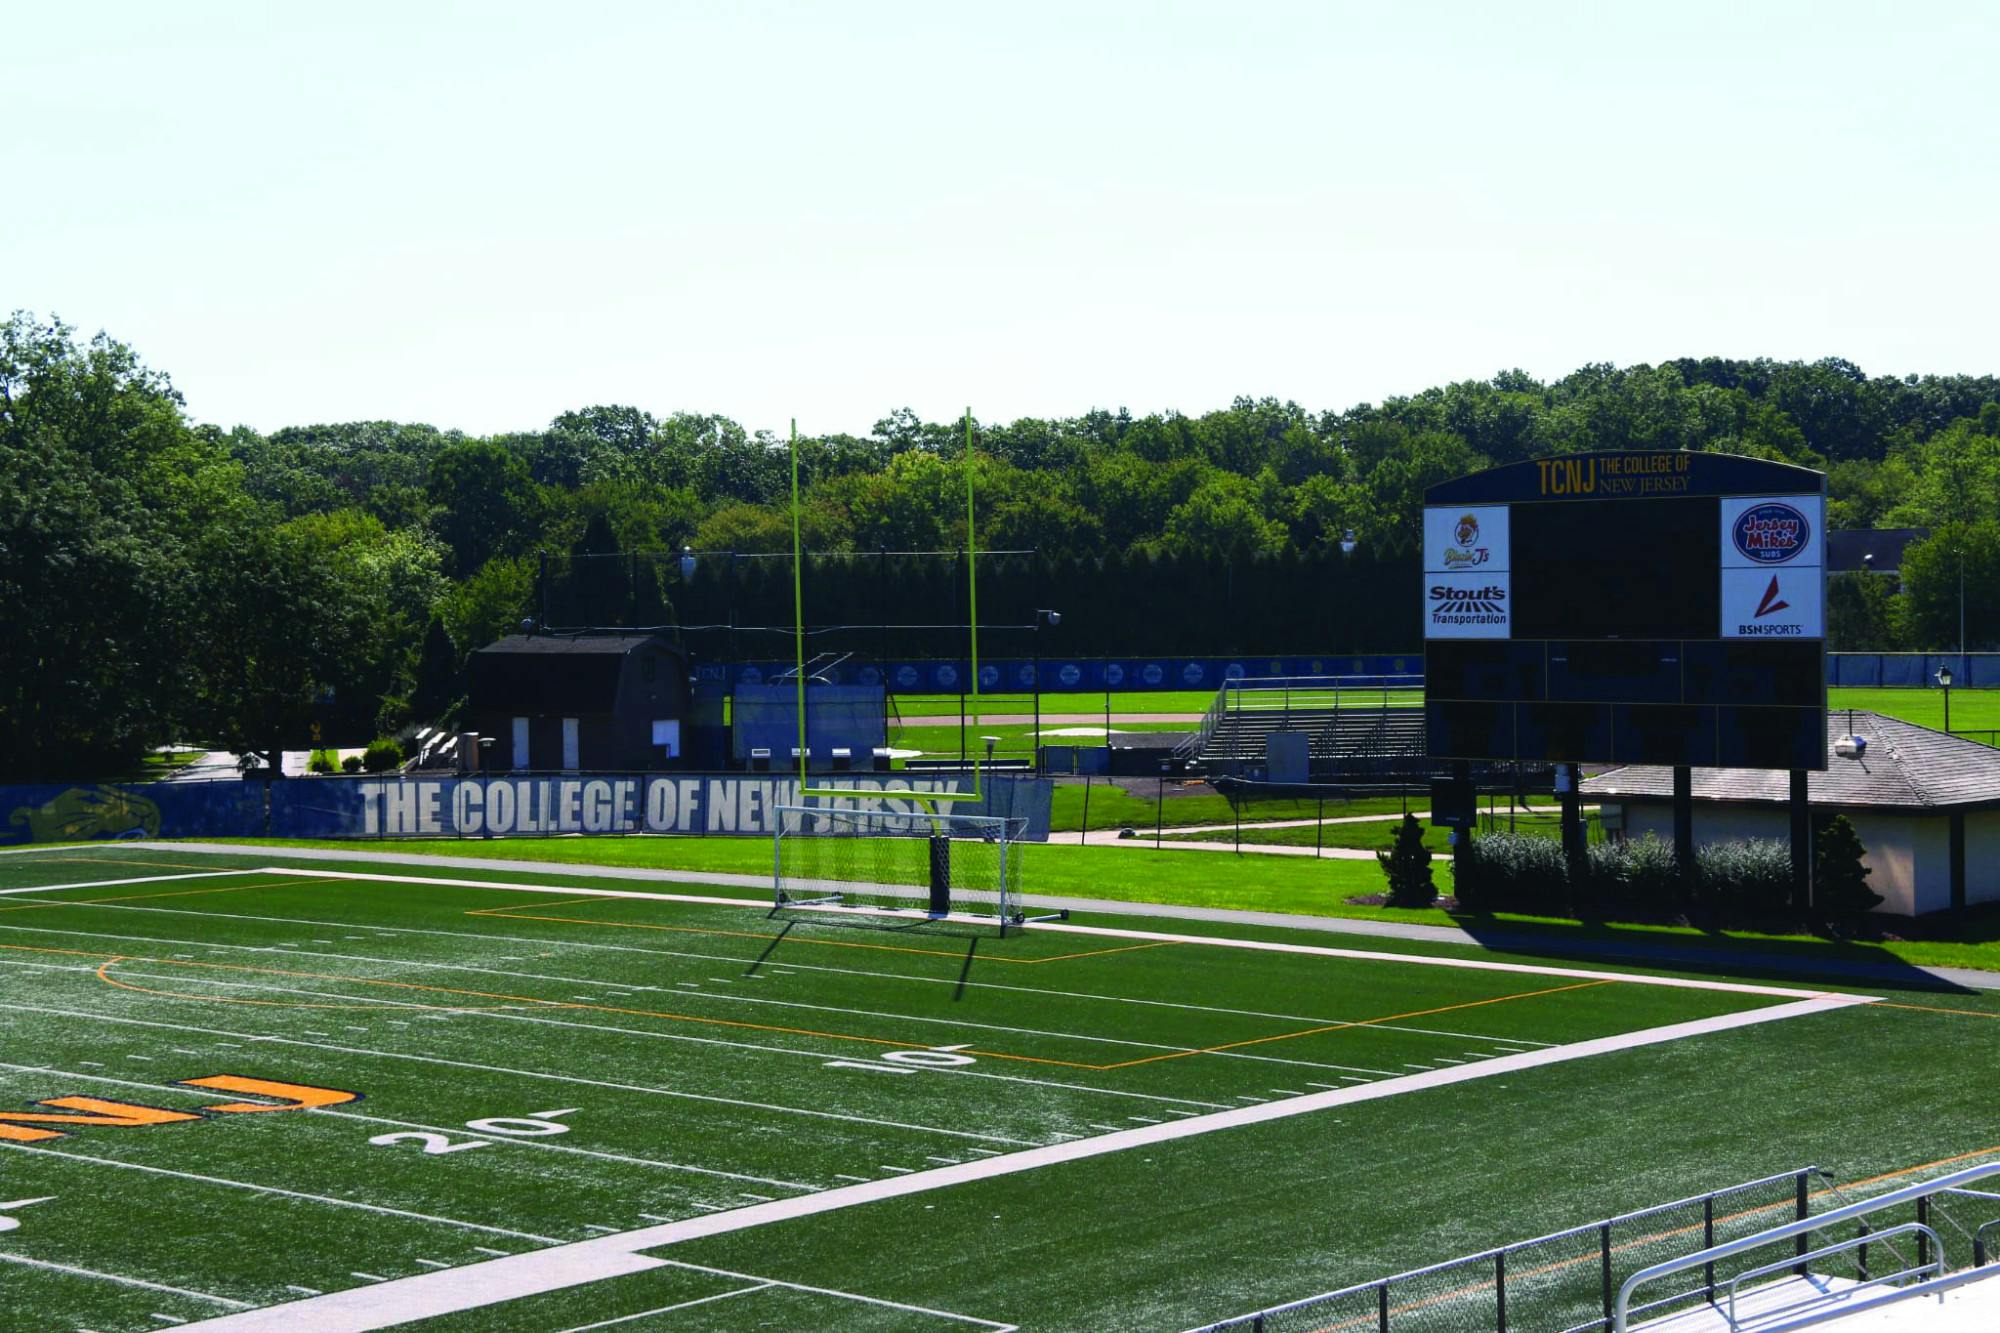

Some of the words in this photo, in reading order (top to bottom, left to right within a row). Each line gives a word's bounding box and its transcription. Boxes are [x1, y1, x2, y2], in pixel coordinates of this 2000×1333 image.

[1600, 457, 1621, 474] THE
[1624, 454, 1672, 474] COLLEGE
[1675, 453, 1691, 472] OF
[1537, 457, 1596, 496] TCNJ
[1600, 476, 1636, 494] NEW
[1638, 475, 1691, 496] JERSEY
[1743, 514, 1800, 534] Jersey
[1759, 550, 1781, 558] SUBS
[1429, 586, 1505, 601] Stout's
[1432, 613, 1506, 625] Transportation
[359, 783, 441, 834] THE
[452, 780, 635, 834] COLLEGE
[648, 779, 700, 833] OF
[708, 779, 798, 833] NEW
[813, 780, 959, 834] JERSEY
[368, 1117, 570, 1154] 20
